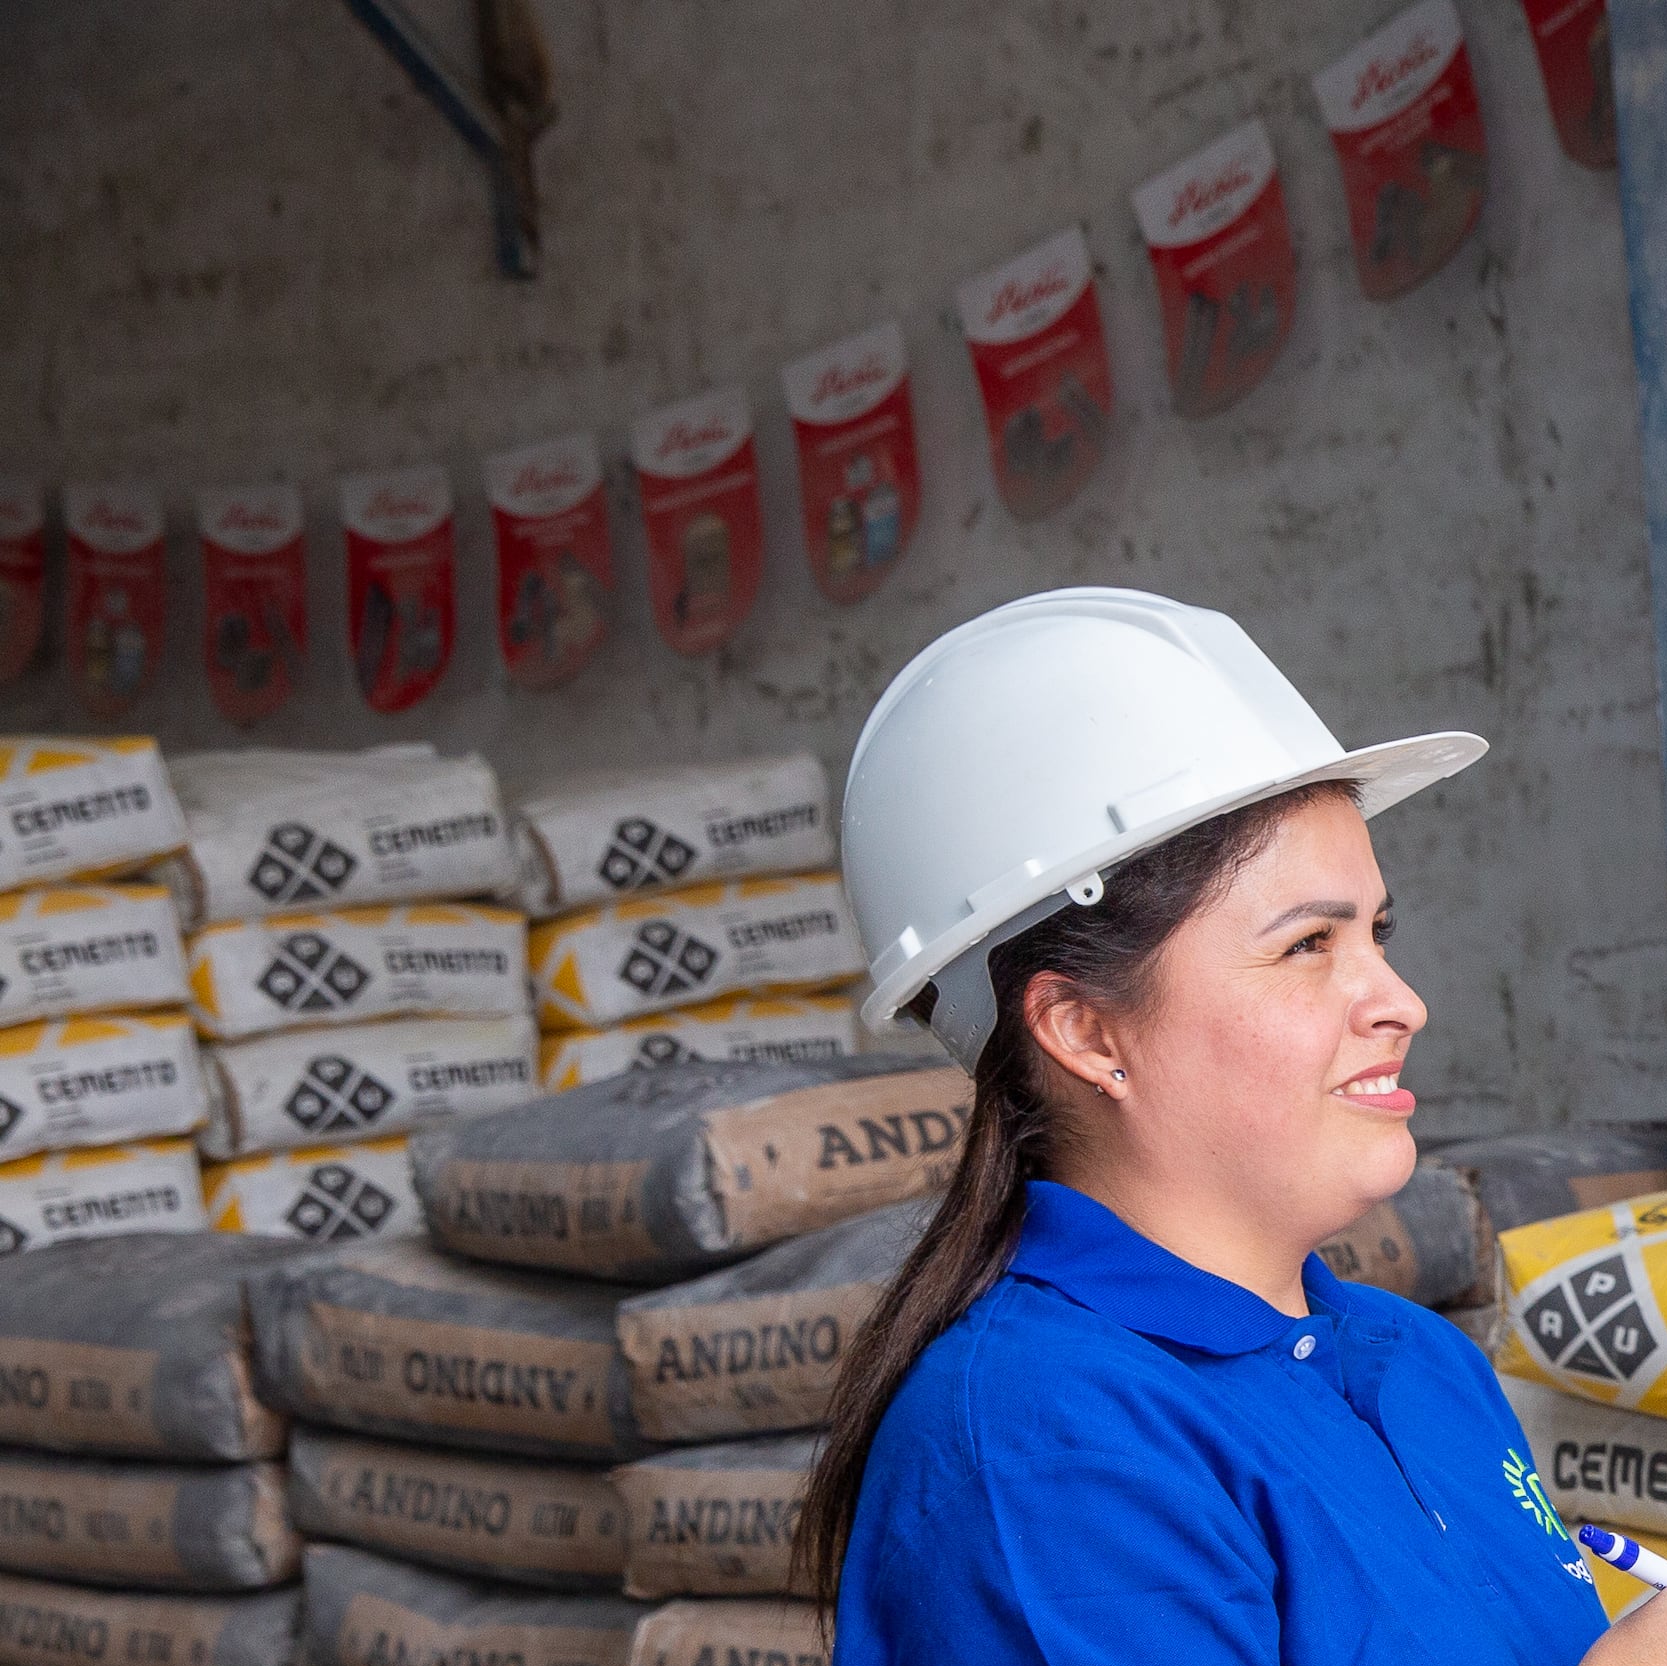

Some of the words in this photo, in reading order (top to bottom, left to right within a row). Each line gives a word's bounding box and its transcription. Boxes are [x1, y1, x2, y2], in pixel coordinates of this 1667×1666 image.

[818, 1106, 974, 1170] AND
[403, 1350, 575, 1413] ANDINO
[655, 1315, 838, 1385] ANDINO
[350, 1468, 510, 1536] ANDINO
